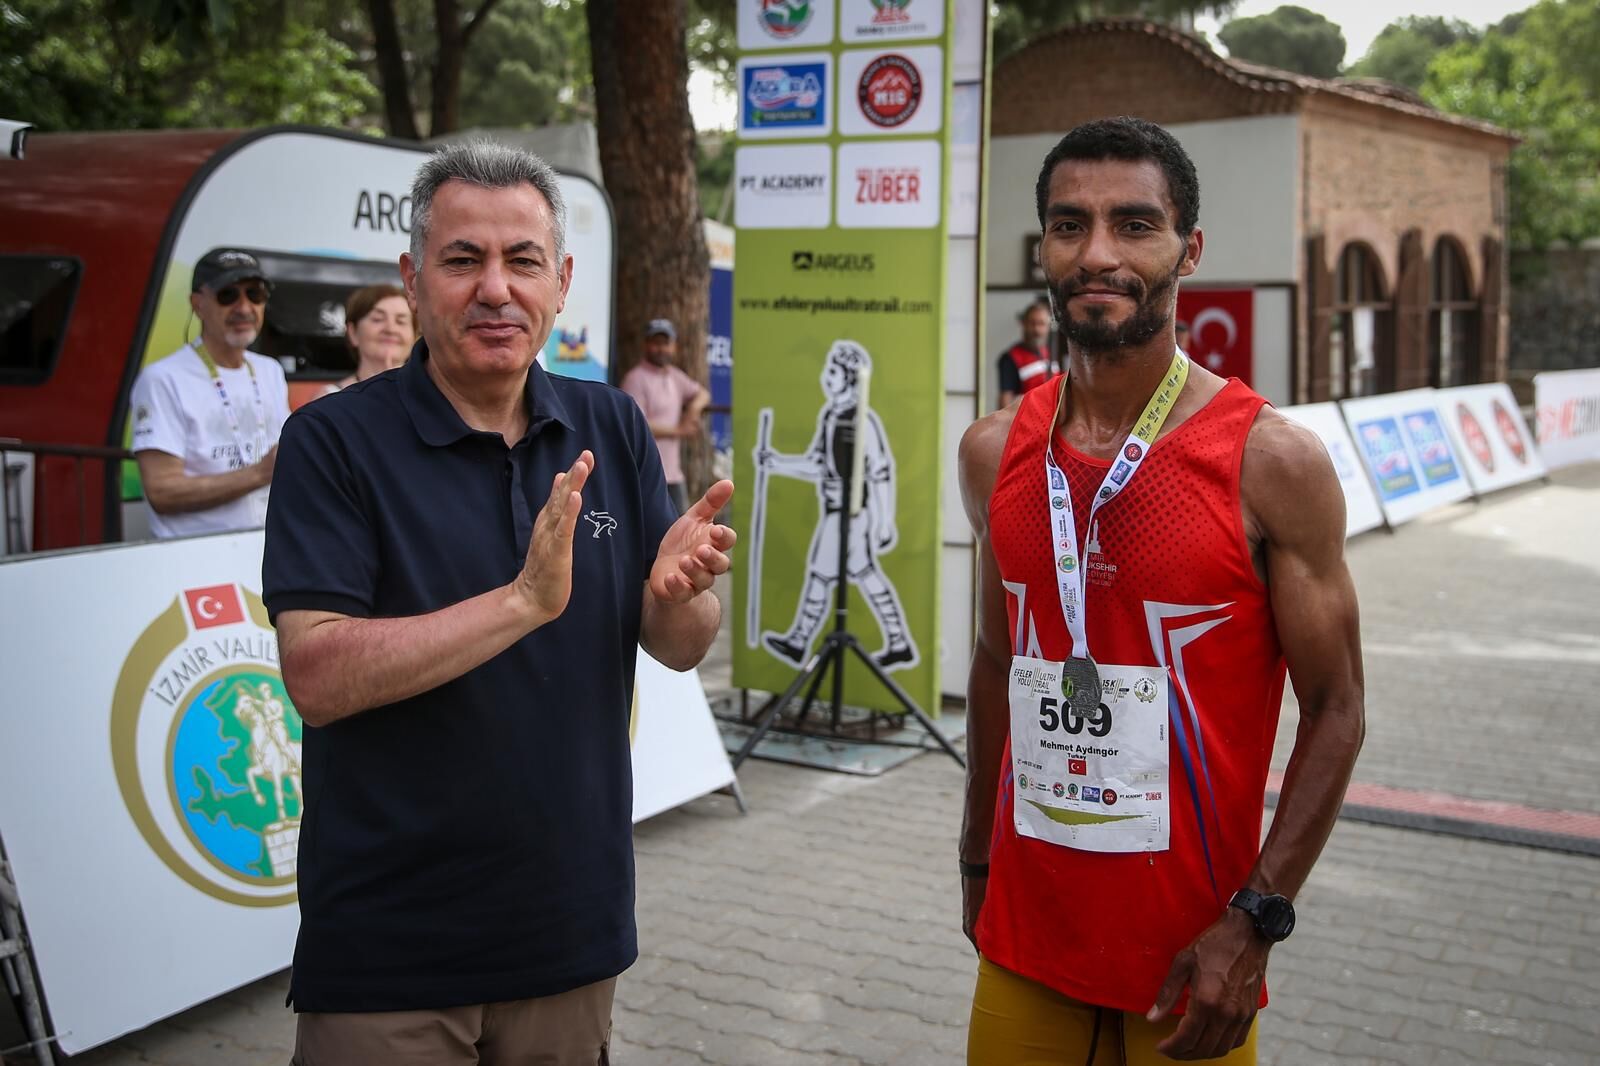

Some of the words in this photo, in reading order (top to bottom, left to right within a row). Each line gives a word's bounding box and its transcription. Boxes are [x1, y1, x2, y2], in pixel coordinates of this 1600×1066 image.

[740, 176, 755, 191] PT
[761, 174, 825, 190] ACADEMY
[814, 253, 875, 272] ARGEUS
[150, 647, 214, 707] İZMİR
[214, 634, 278, 662] VALİL
[1013, 668, 1033, 679] EFELER
[1039, 672, 1057, 683] ULTRA
[1017, 676, 1032, 687] YOLU
[1034, 679, 1050, 690] TRAIL
[1039, 697, 1113, 737] 509
[1040, 739, 1074, 752] Mehmet
[1075, 745, 1119, 758] Aydıngör
[1067, 752, 1087, 761] Turkey
